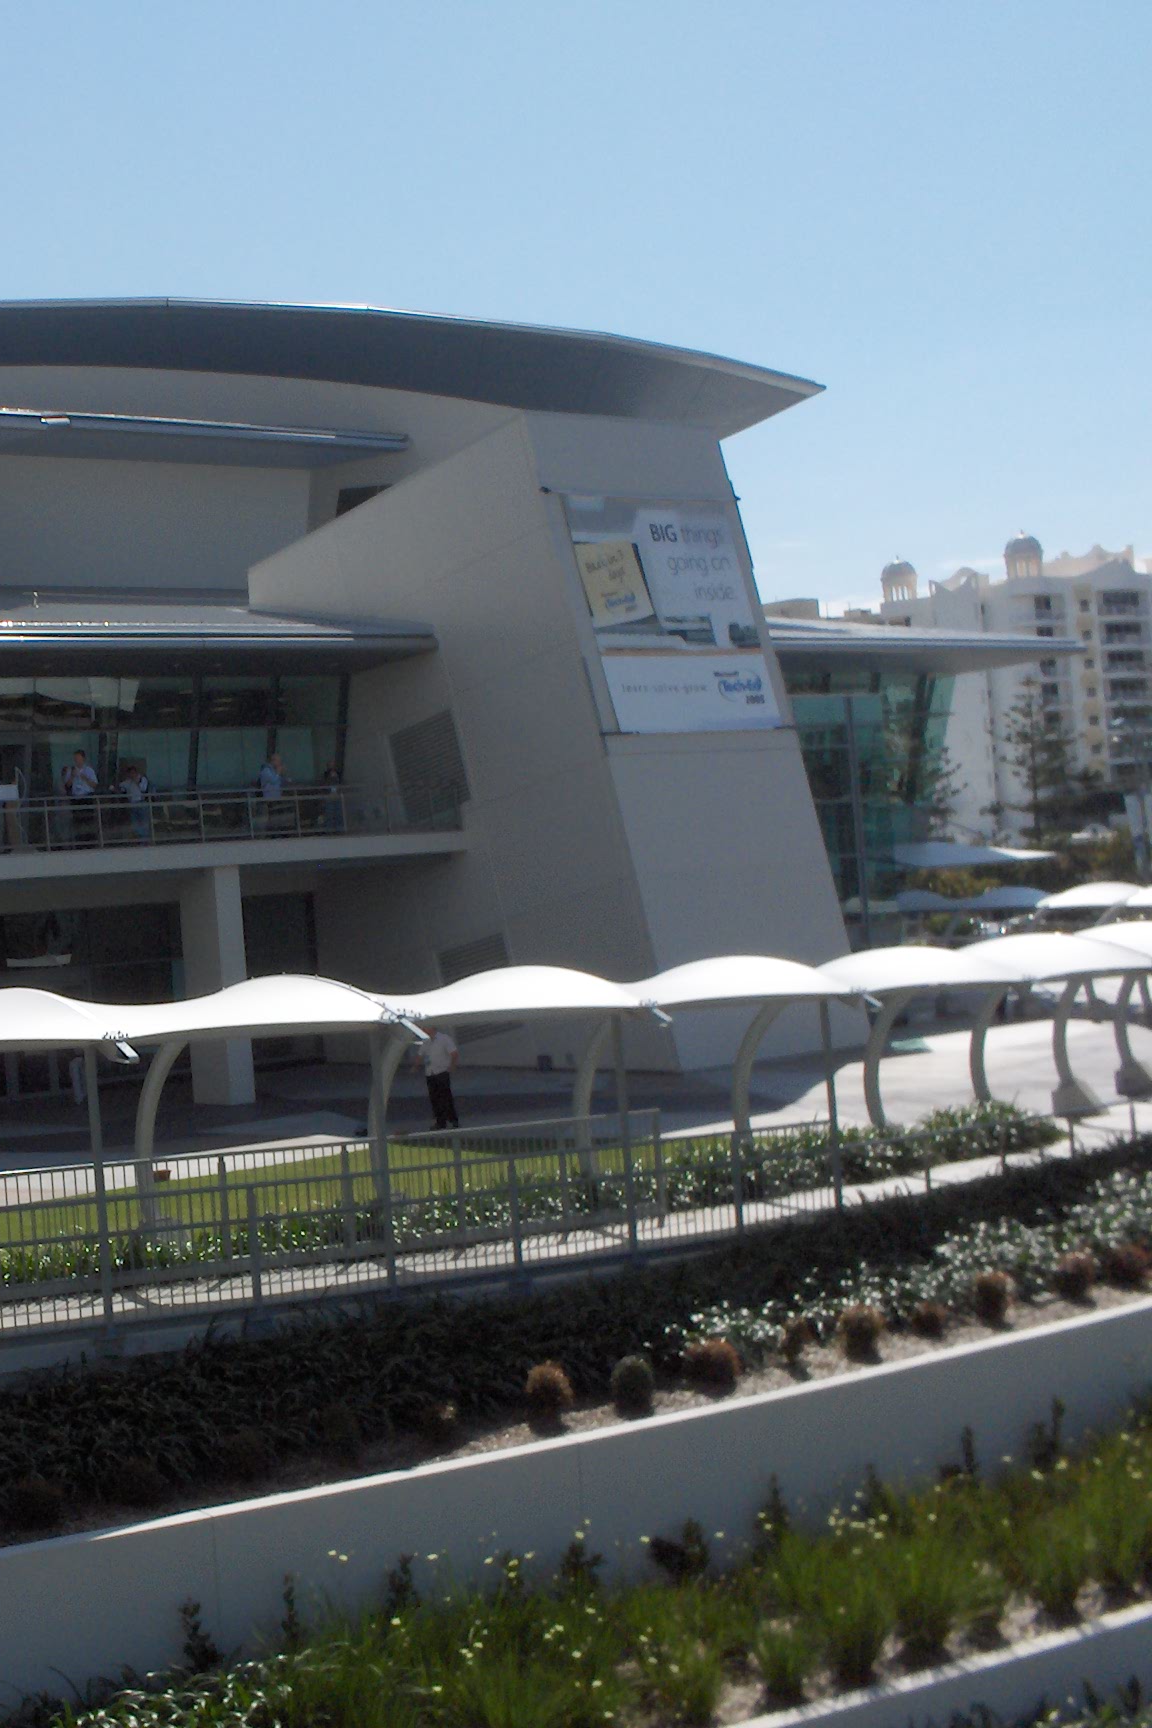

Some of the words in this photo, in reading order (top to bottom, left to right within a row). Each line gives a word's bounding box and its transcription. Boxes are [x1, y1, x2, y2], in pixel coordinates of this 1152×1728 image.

[649, 523, 678, 543] BIG
[680, 522, 724, 549] things
[667, 555, 709, 577] going
[711, 557, 730, 571] on
[694, 582, 735, 600] inside
